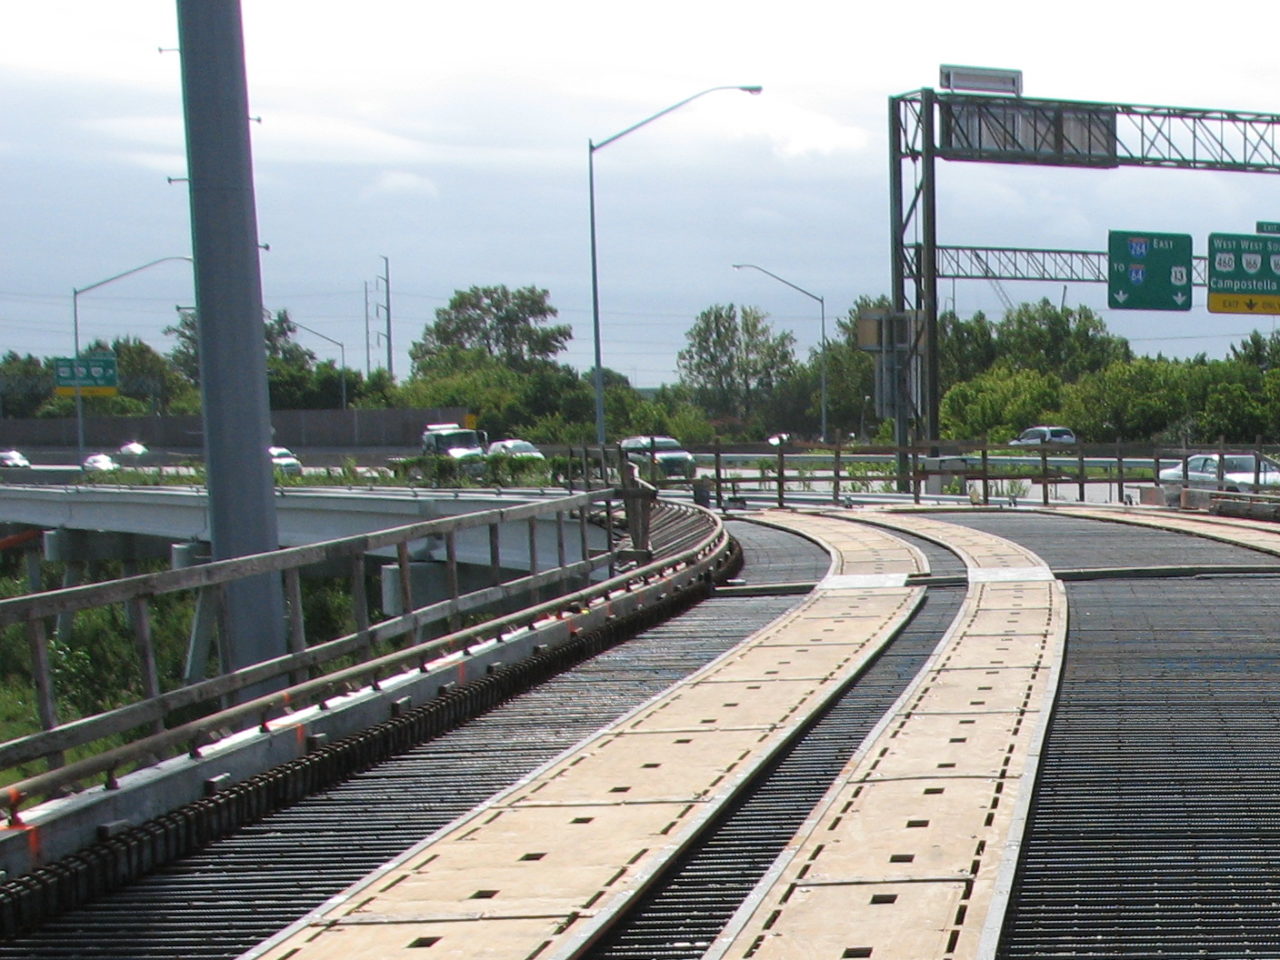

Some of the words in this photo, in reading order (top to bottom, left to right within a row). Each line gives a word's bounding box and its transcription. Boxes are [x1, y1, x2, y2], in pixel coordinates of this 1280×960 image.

[1130, 243, 1146, 255] 264
[1153, 238, 1174, 249] EAST
[1214, 239, 1236, 249] WEST
[1241, 241, 1263, 250] WEST
[1217, 257, 1233, 268] 460
[1246, 258, 1258, 269] 166
[1113, 264, 1125, 272] TO
[1131, 270, 1143, 281] 64
[1174, 270, 1184, 281] 13
[1210, 278, 1277, 291] Campostella
[1222, 300, 1239, 308] EXIT
